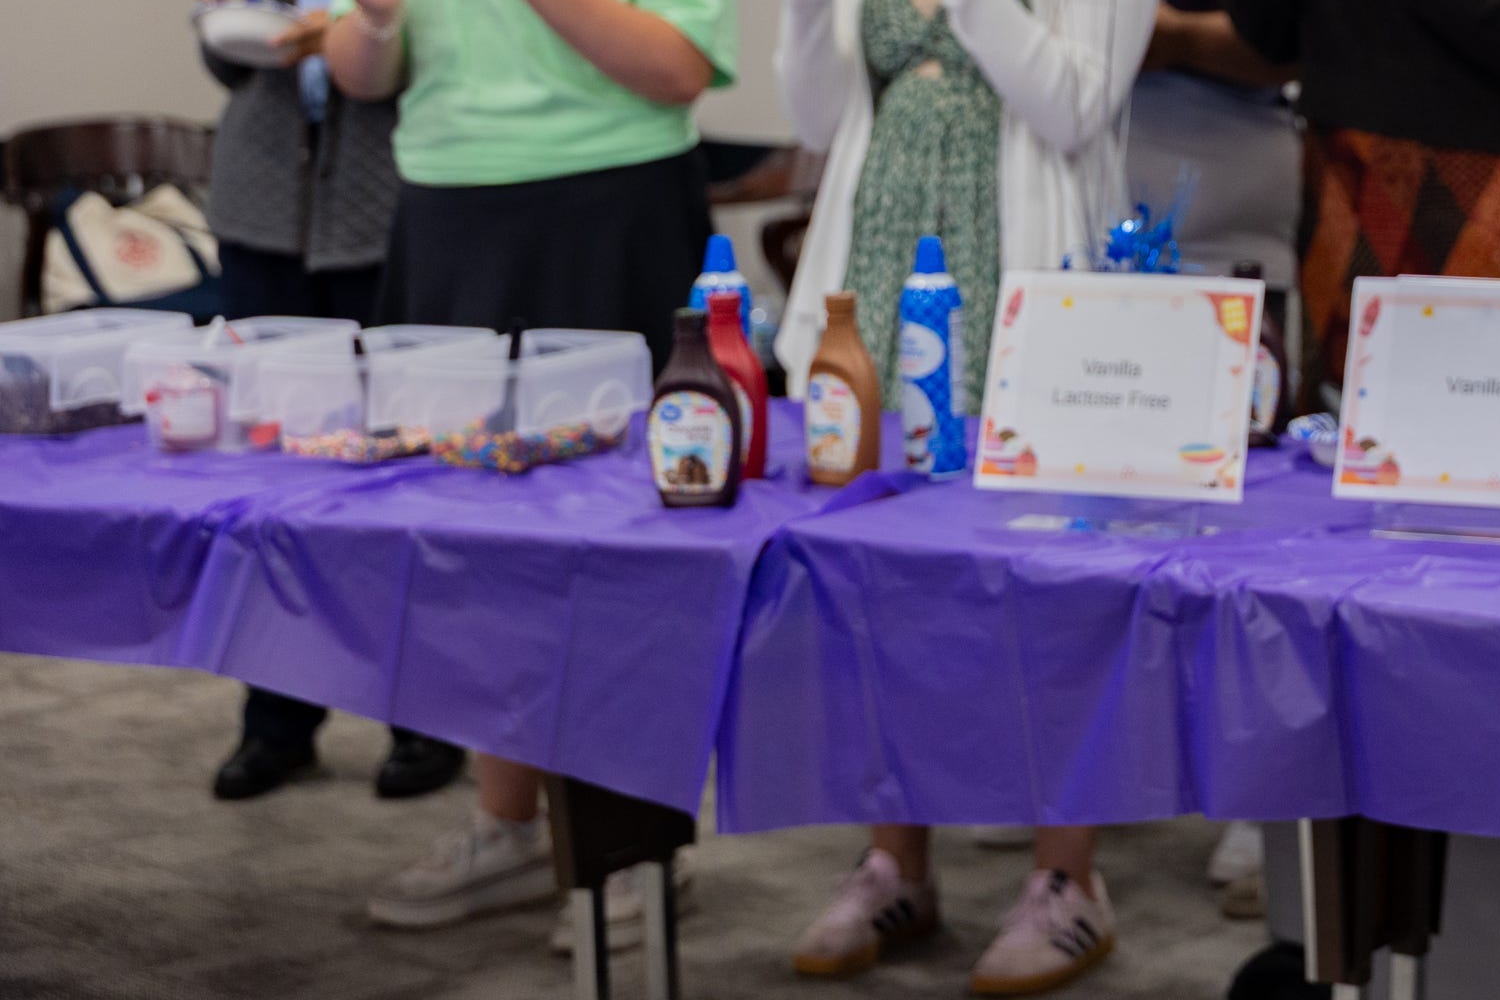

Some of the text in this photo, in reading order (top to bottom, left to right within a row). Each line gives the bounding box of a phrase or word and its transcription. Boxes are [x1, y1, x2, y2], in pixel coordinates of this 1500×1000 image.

[1081, 357, 1142, 377] Vanilla
[1052, 386, 1171, 410] Lactose Free
